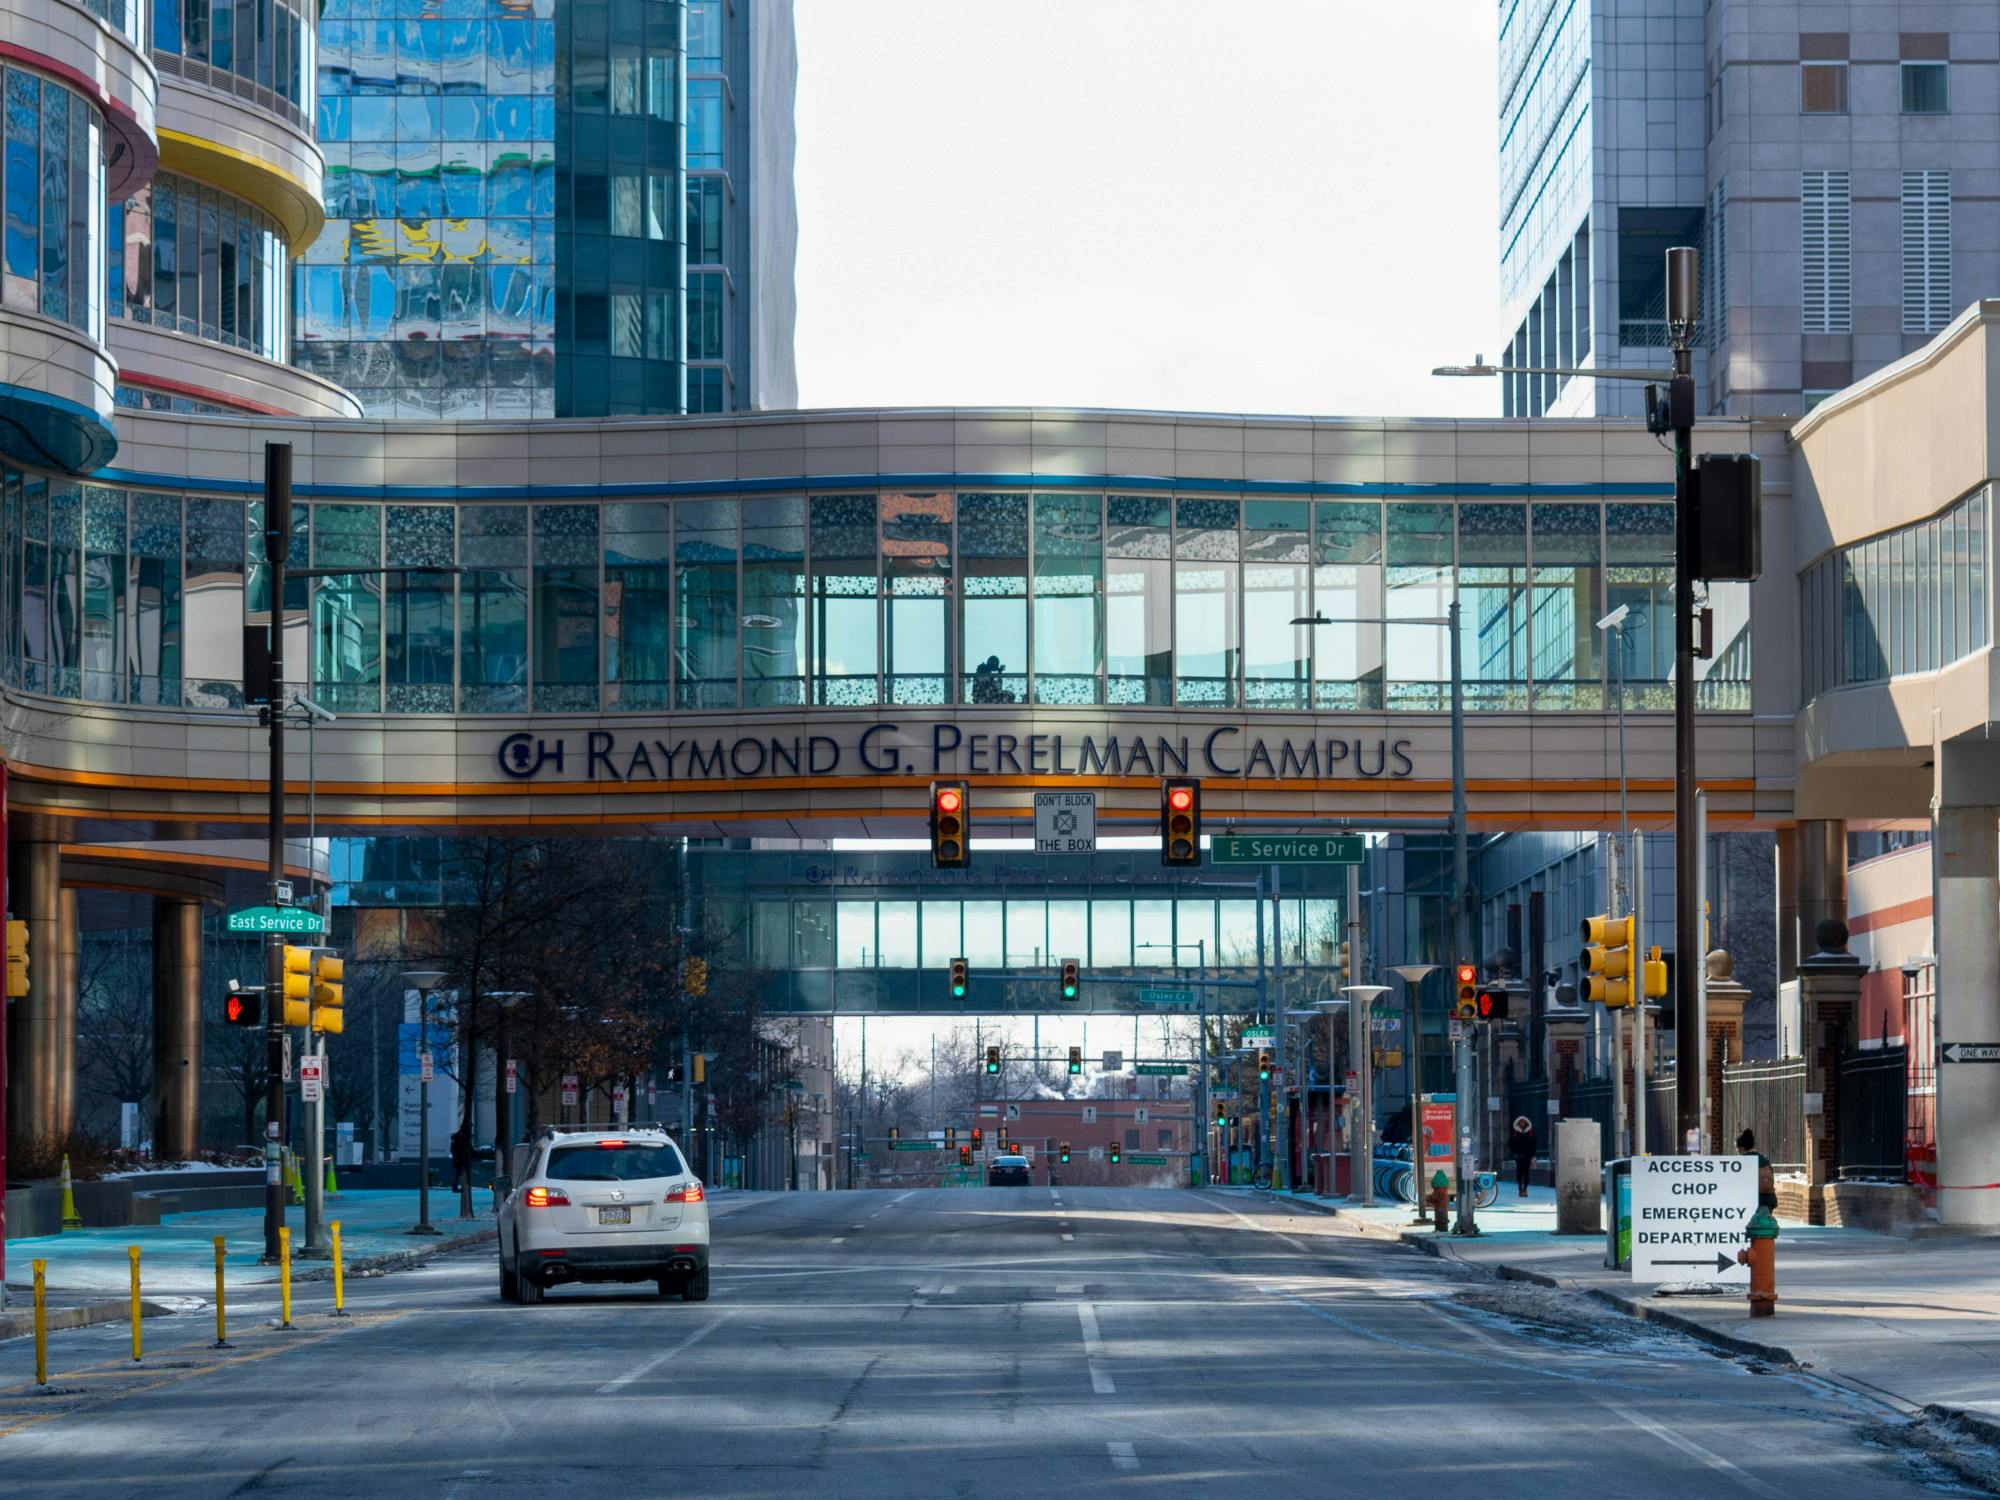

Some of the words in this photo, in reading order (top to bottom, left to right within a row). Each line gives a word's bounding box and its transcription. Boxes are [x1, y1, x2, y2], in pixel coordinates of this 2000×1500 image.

[587, 731, 841, 779] RAYMOND
[859, 724, 914, 773] G.
[933, 724, 1188, 774] PERELMAN
[1204, 726, 1413, 777] CAMPUS
[1037, 795, 1062, 806] DON'T
[1065, 795, 1092, 806] BLOCK
[1038, 839, 1061, 851] THE
[1068, 839, 1092, 851] BOX
[1231, 841, 1245, 856] E.
[1252, 841, 1318, 856] Service
[1326, 841, 1345, 856] Dr
[230, 915, 255, 929] East
[260, 915, 303, 930] Service
[308, 918, 320, 930] Dr
[1149, 991, 1173, 1000] Osler
[1961, 1048, 1977, 1057] ONE
[1981, 1049, 1999, 1057] WAY
[1648, 1160, 1714, 1173] ACCESS
[1720, 1160, 1742, 1173] TO
[1672, 1183, 1718, 1195] CHOP
[1642, 1207, 1747, 1220] EMERGENCY
[1638, 1231, 1749, 1244] DEPARTMENT
